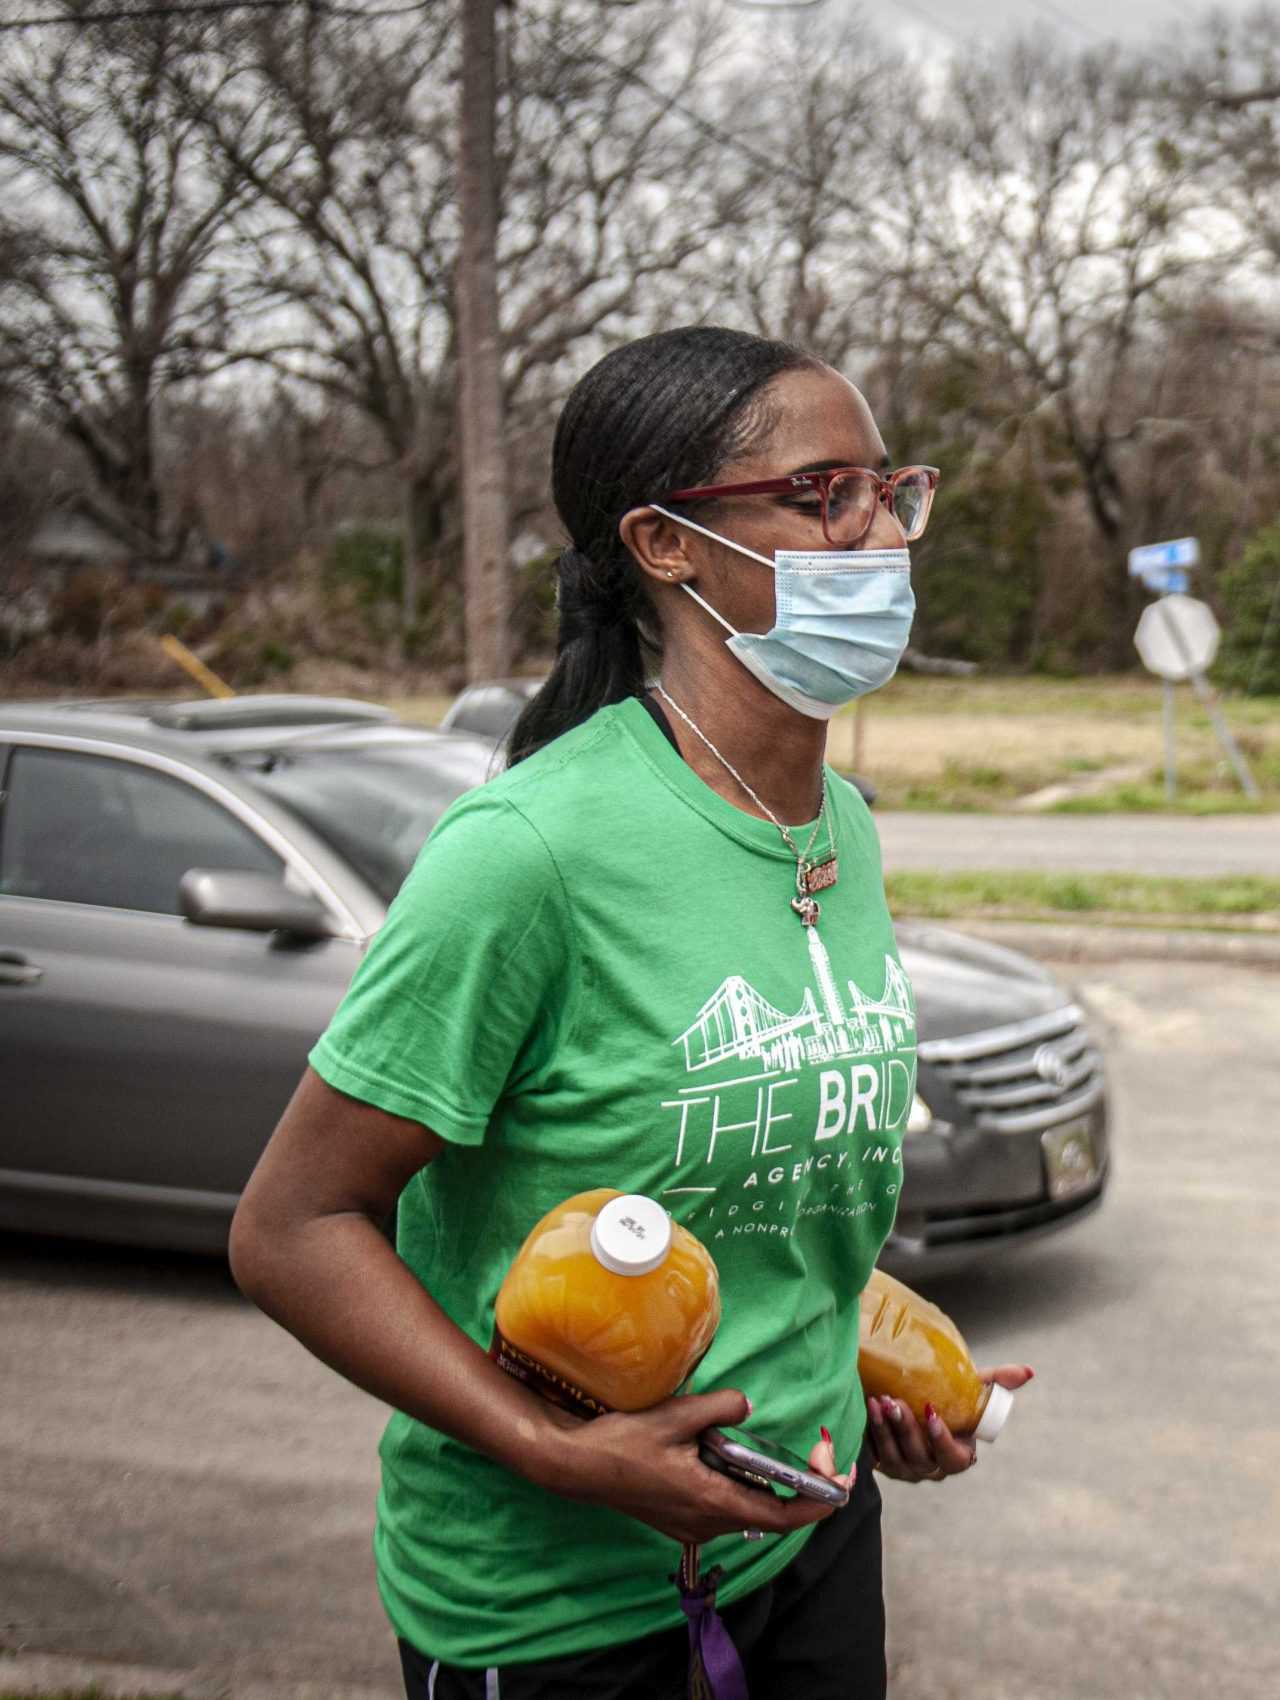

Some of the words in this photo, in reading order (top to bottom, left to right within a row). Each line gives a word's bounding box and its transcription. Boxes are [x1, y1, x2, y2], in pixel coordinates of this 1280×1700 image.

[661, 1078, 799, 1166] THE
[814, 1059, 916, 1142] BRID
[714, 1228, 725, 1239] A
